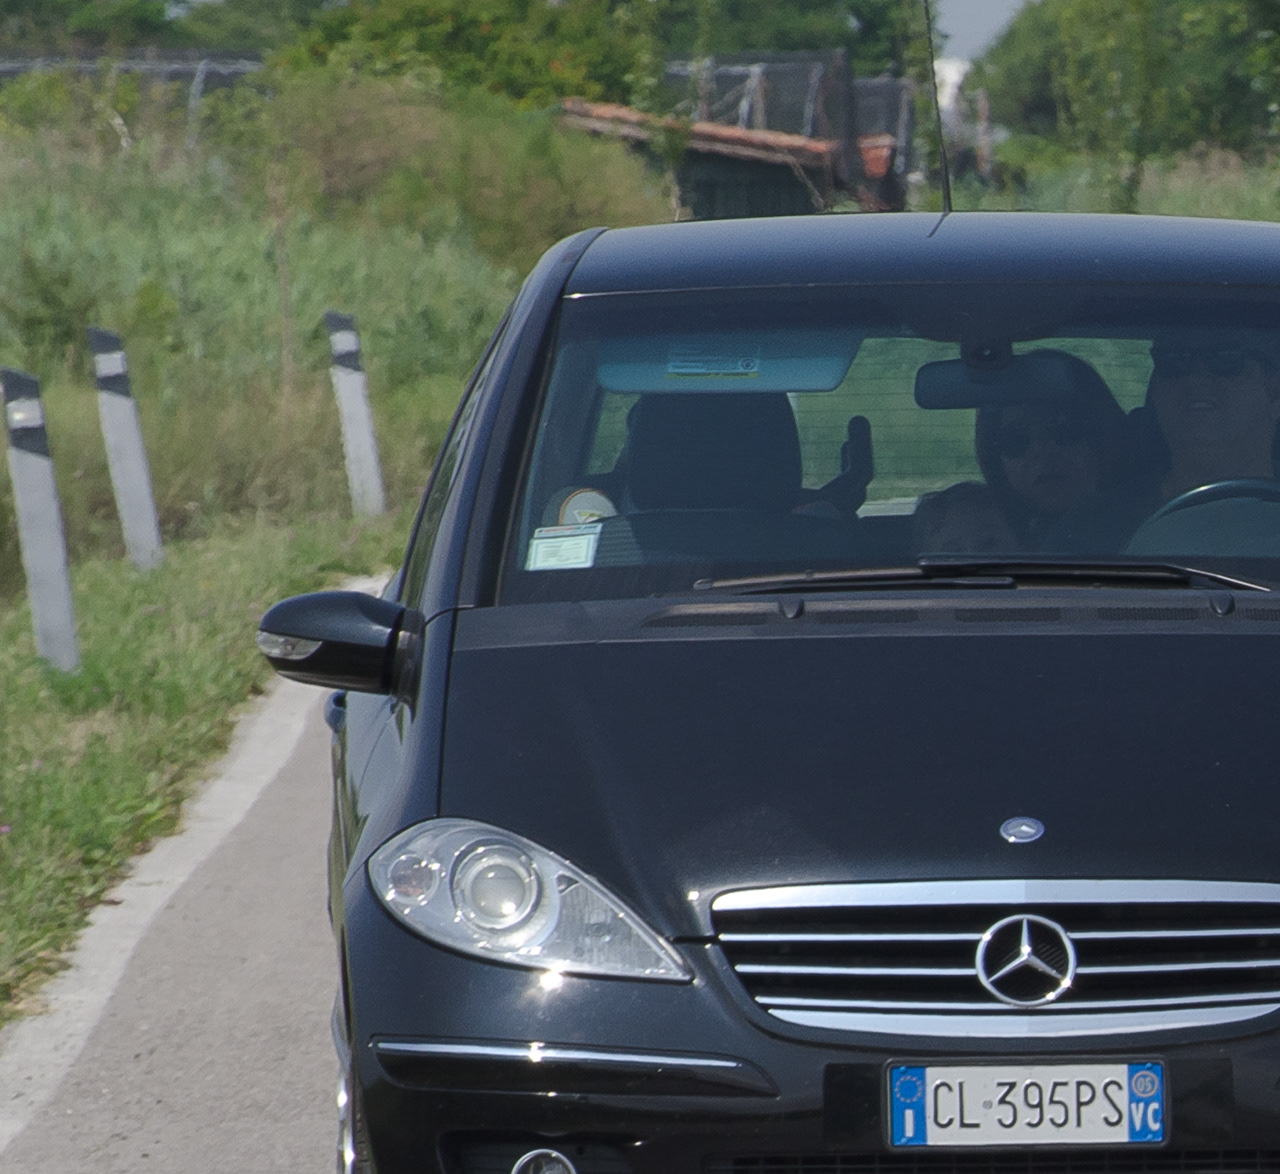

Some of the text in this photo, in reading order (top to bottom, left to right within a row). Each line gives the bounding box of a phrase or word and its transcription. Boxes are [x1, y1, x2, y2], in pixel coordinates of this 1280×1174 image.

[1137, 1076, 1153, 1093] 05
[933, 1080, 1123, 1129] CL 395PS
[1130, 1102, 1160, 1132] VC
[904, 1109, 914, 1137] I
